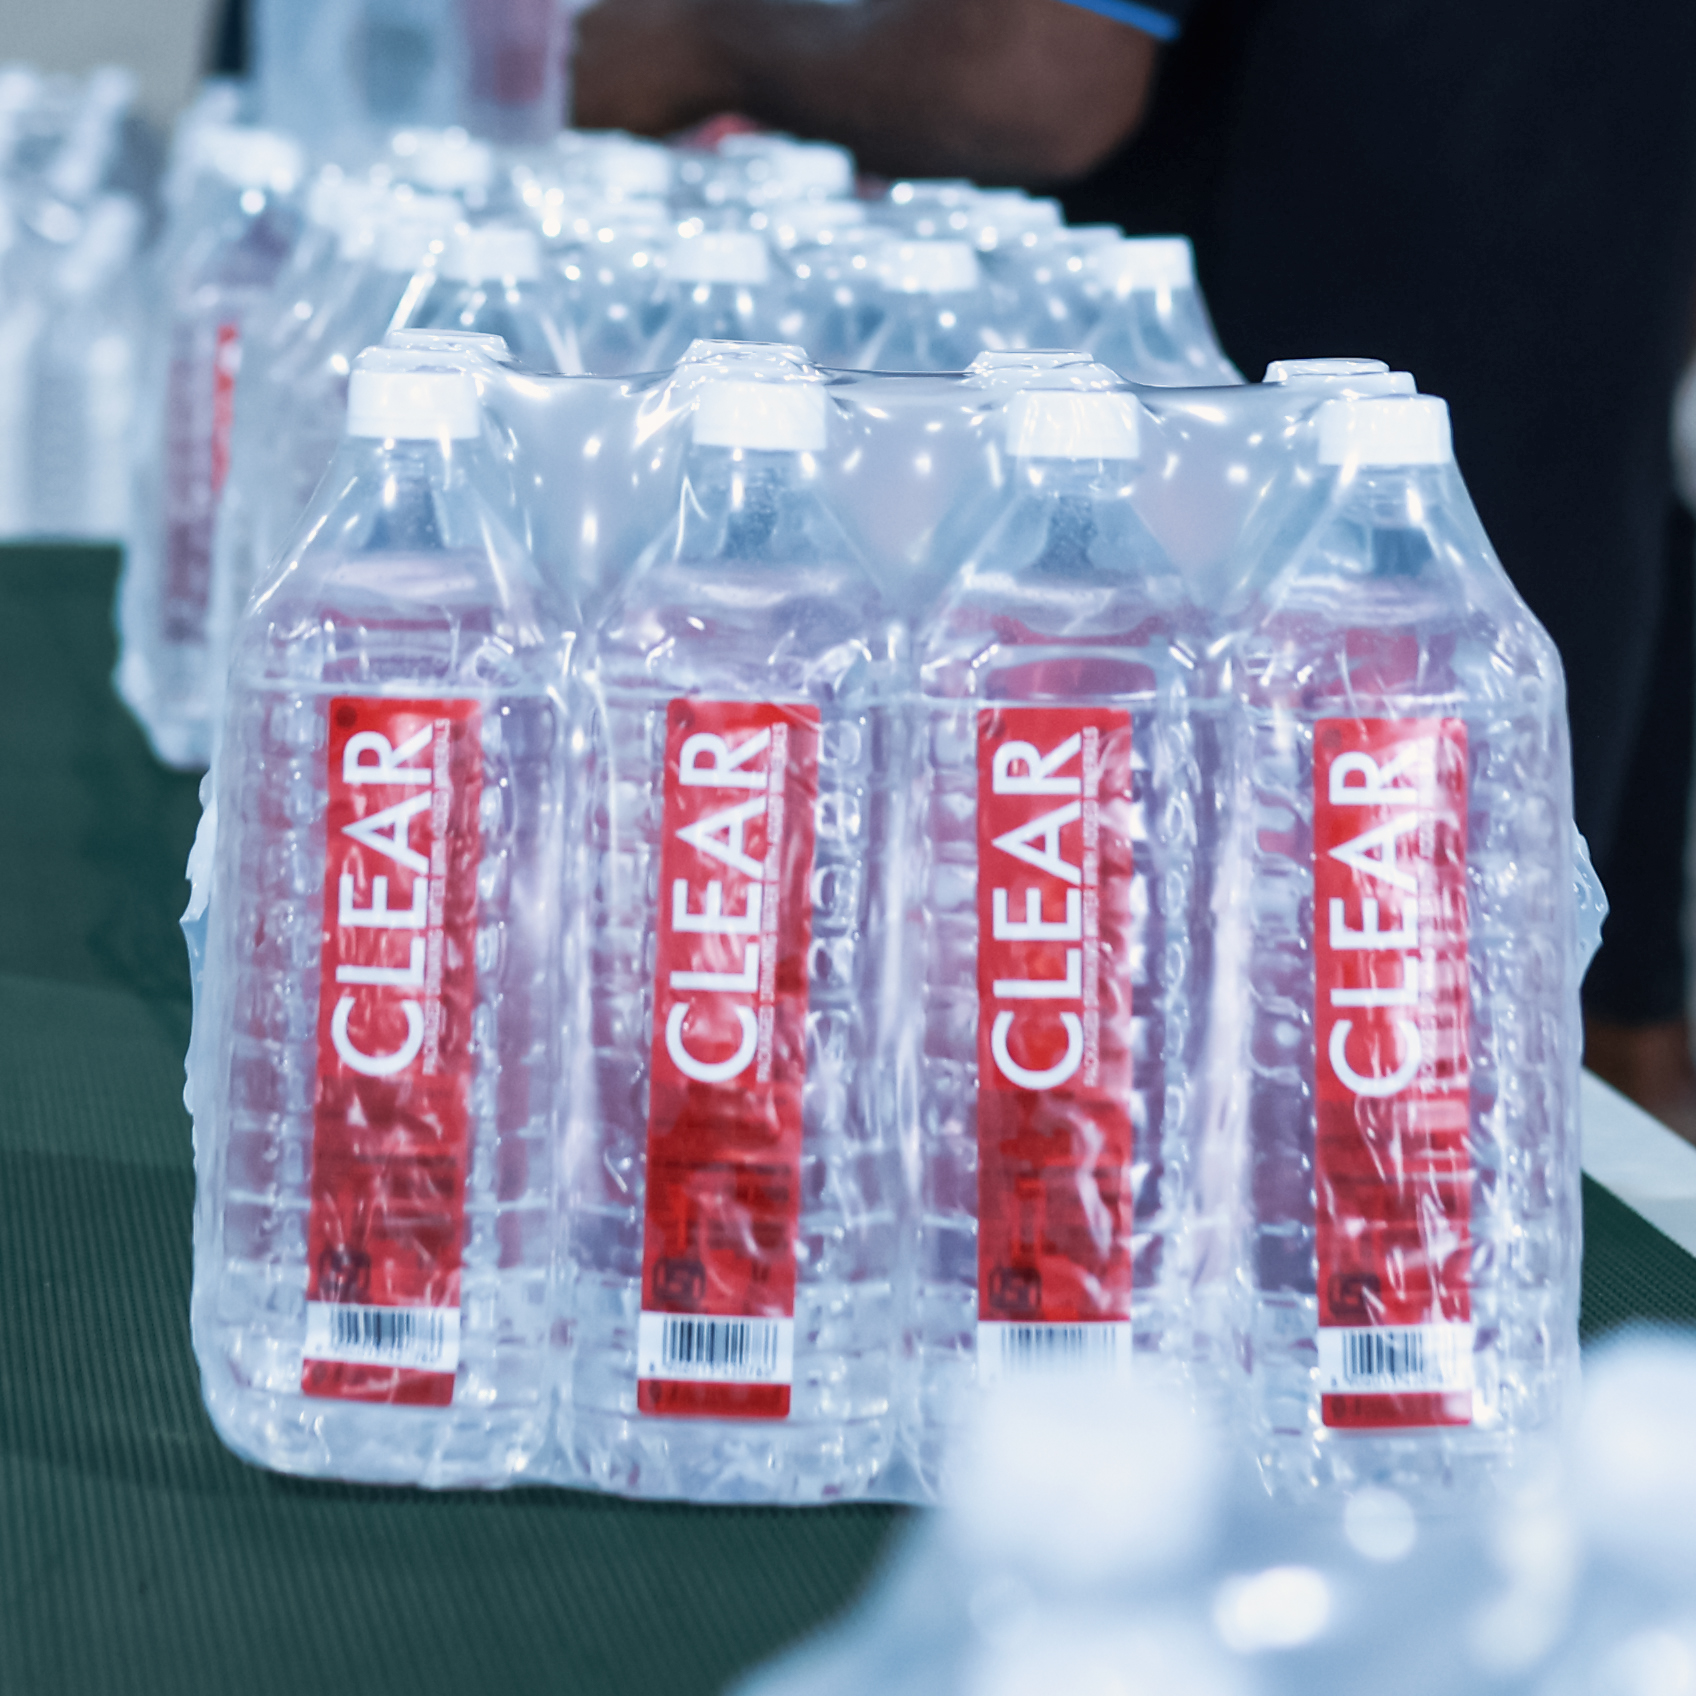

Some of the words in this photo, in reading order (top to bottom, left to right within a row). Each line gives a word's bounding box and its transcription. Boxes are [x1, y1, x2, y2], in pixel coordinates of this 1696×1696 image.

[331, 725, 433, 1076] CLEAR
[422, 1001, 440, 1075] PACKAGED
[666, 727, 770, 1083] CLEAR
[756, 1006, 774, 1083] PACKAGED
[991, 732, 1083, 1090] CLEAR
[1083, 1010, 1099, 1088] PACKAGED
[1328, 741, 1421, 1097] CLEAR
